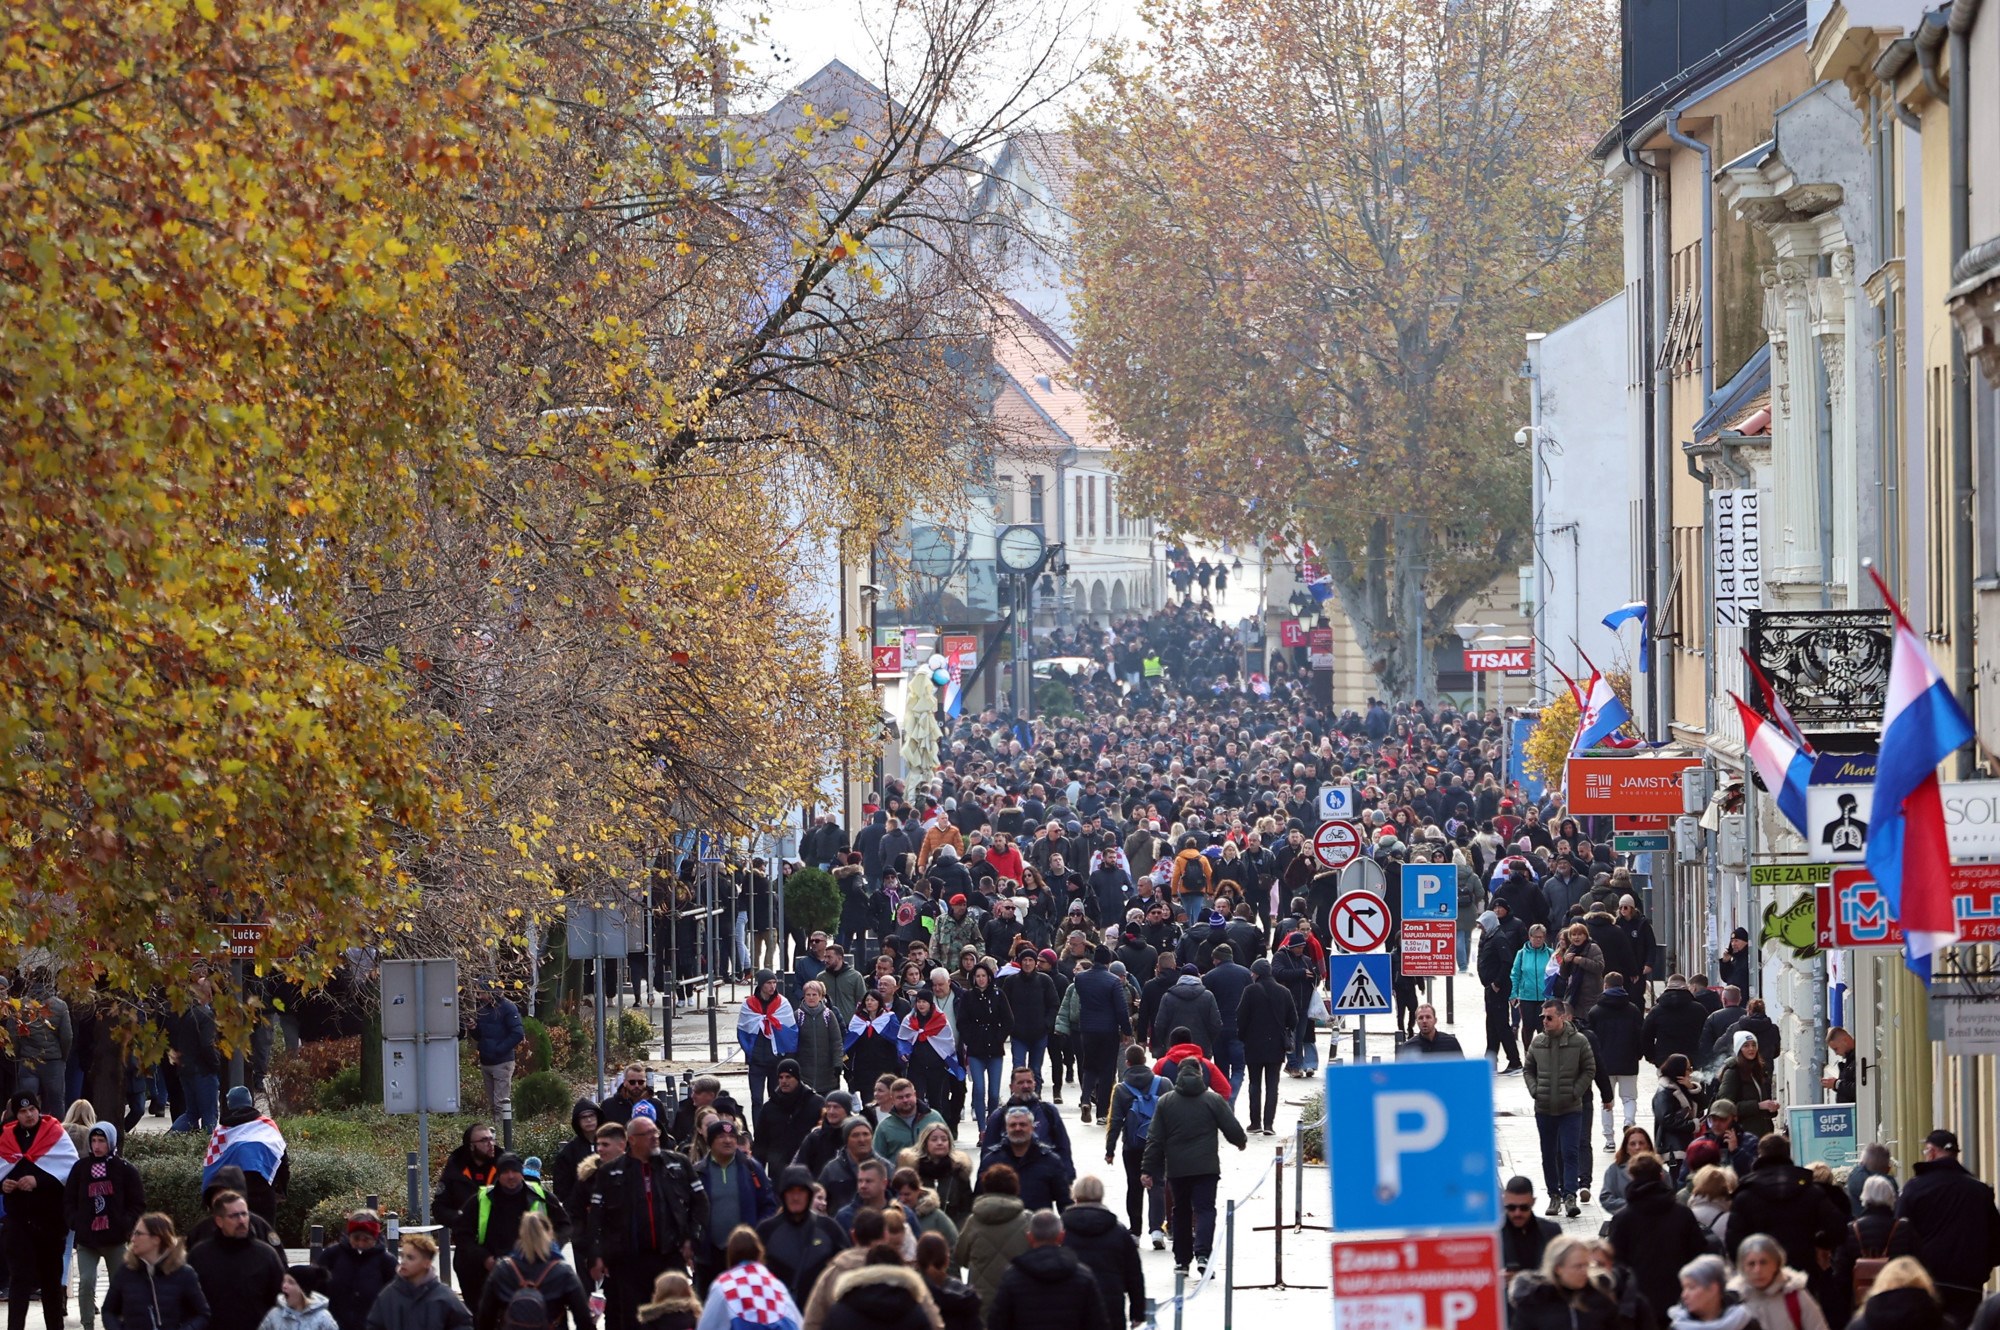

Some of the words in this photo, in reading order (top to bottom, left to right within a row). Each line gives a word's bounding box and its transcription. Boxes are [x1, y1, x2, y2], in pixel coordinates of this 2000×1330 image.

[1716, 492, 1736, 625] Zlatarna
[1737, 492, 1760, 624] Zlatarna
[1469, 653, 1526, 668] TISAK
[1835, 762, 1877, 779] Mart
[1754, 867, 1782, 883] SVE
[1785, 867, 1805, 882] ZA
[1417, 874, 1441, 909] P
[232, 929, 261, 940] Lučka
[1404, 923, 1424, 931] Zona
[1425, 923, 1430, 931] 1
[1437, 940, 1447, 953] P
[1819, 1114, 1847, 1124] GIFT
[1820, 1123, 1847, 1133] SHOP
[1373, 1089, 1448, 1200] P
[1442, 1290, 1478, 1330] P
